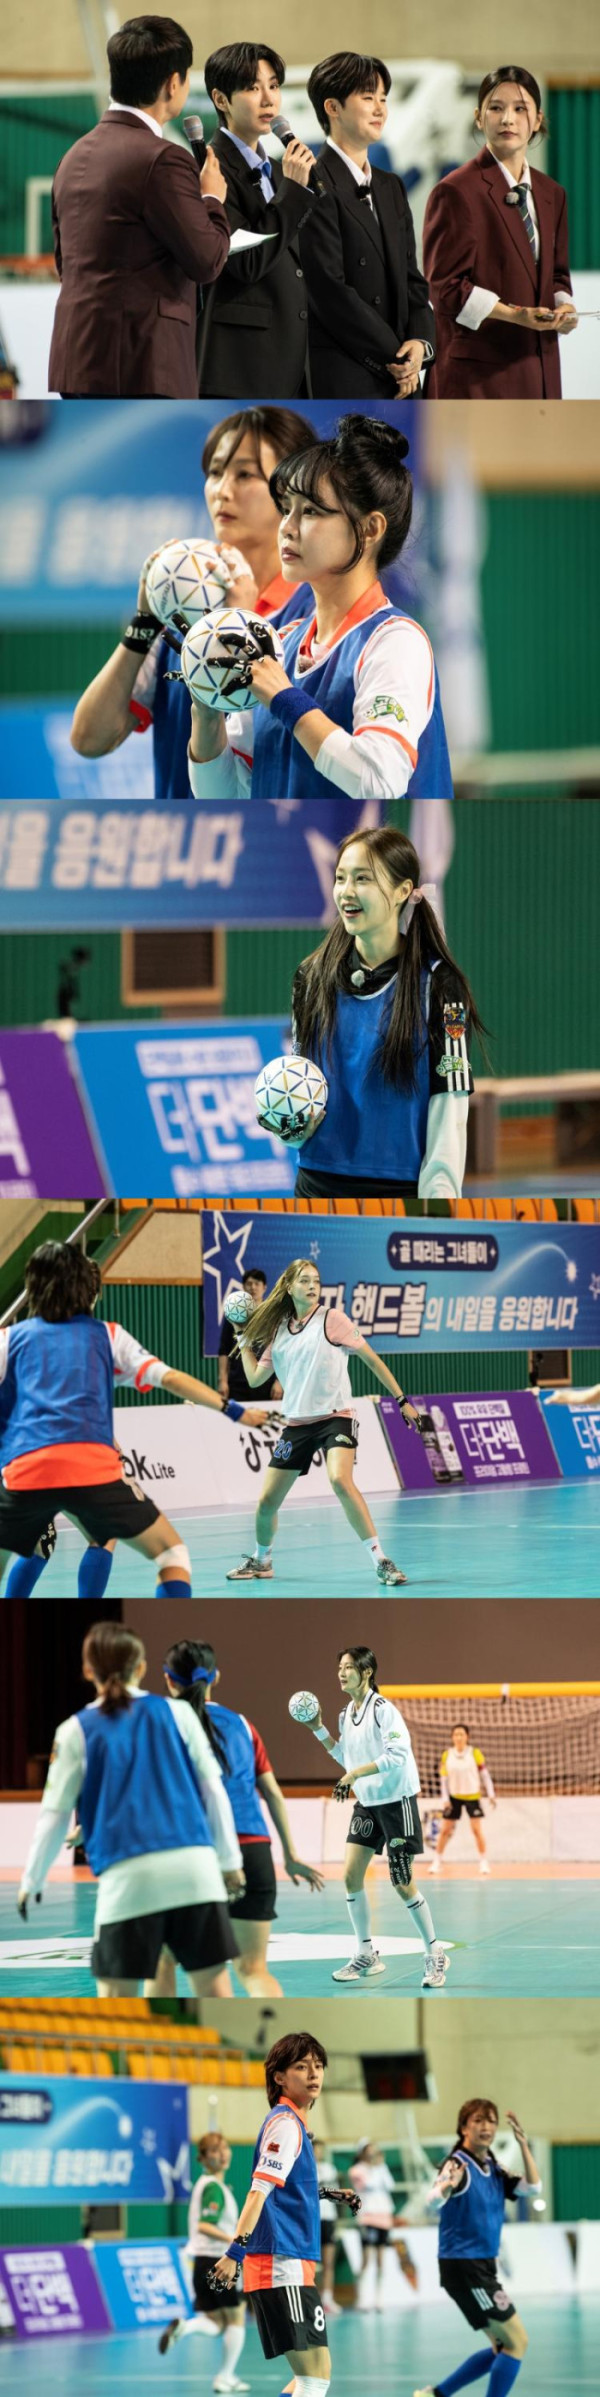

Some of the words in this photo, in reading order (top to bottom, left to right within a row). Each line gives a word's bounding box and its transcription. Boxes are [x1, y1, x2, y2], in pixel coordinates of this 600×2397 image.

[52, 811, 243, 889] 응원합니다
[446, 1297, 497, 1332] 내일을
[500, 1297, 578, 1332] 응원합니다
[273, 1439, 293, 1460] 20
[151, 1462, 176, 1480] Lite
[266, 2159, 284, 2171] SBS
[313, 2305, 325, 2332] 8
